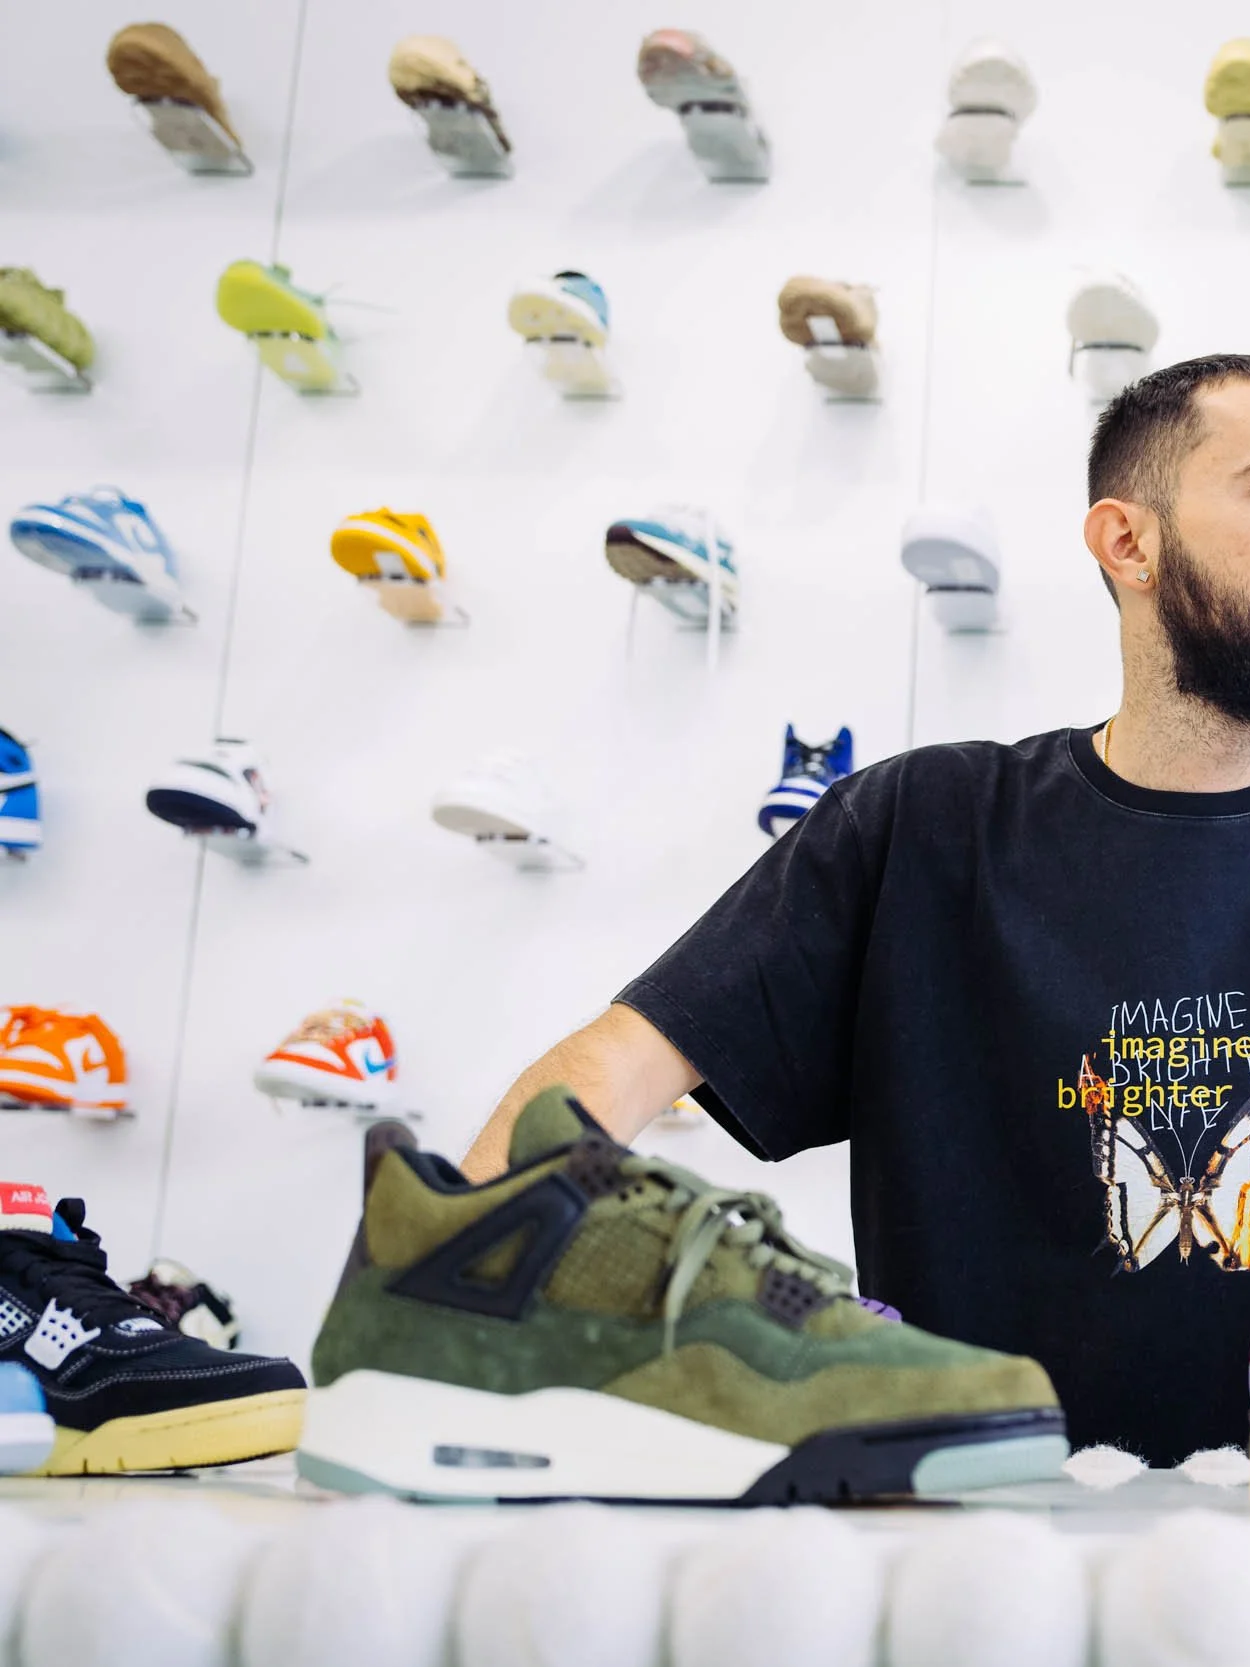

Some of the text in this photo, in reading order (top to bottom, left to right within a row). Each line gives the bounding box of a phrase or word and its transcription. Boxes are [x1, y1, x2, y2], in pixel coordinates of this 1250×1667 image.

[1110, 991, 1247, 1039] IMAGINE
[1078, 1053, 1095, 1089] A
[1058, 1078, 1233, 1117] brighter
[11, 1190, 33, 1203] AIR
